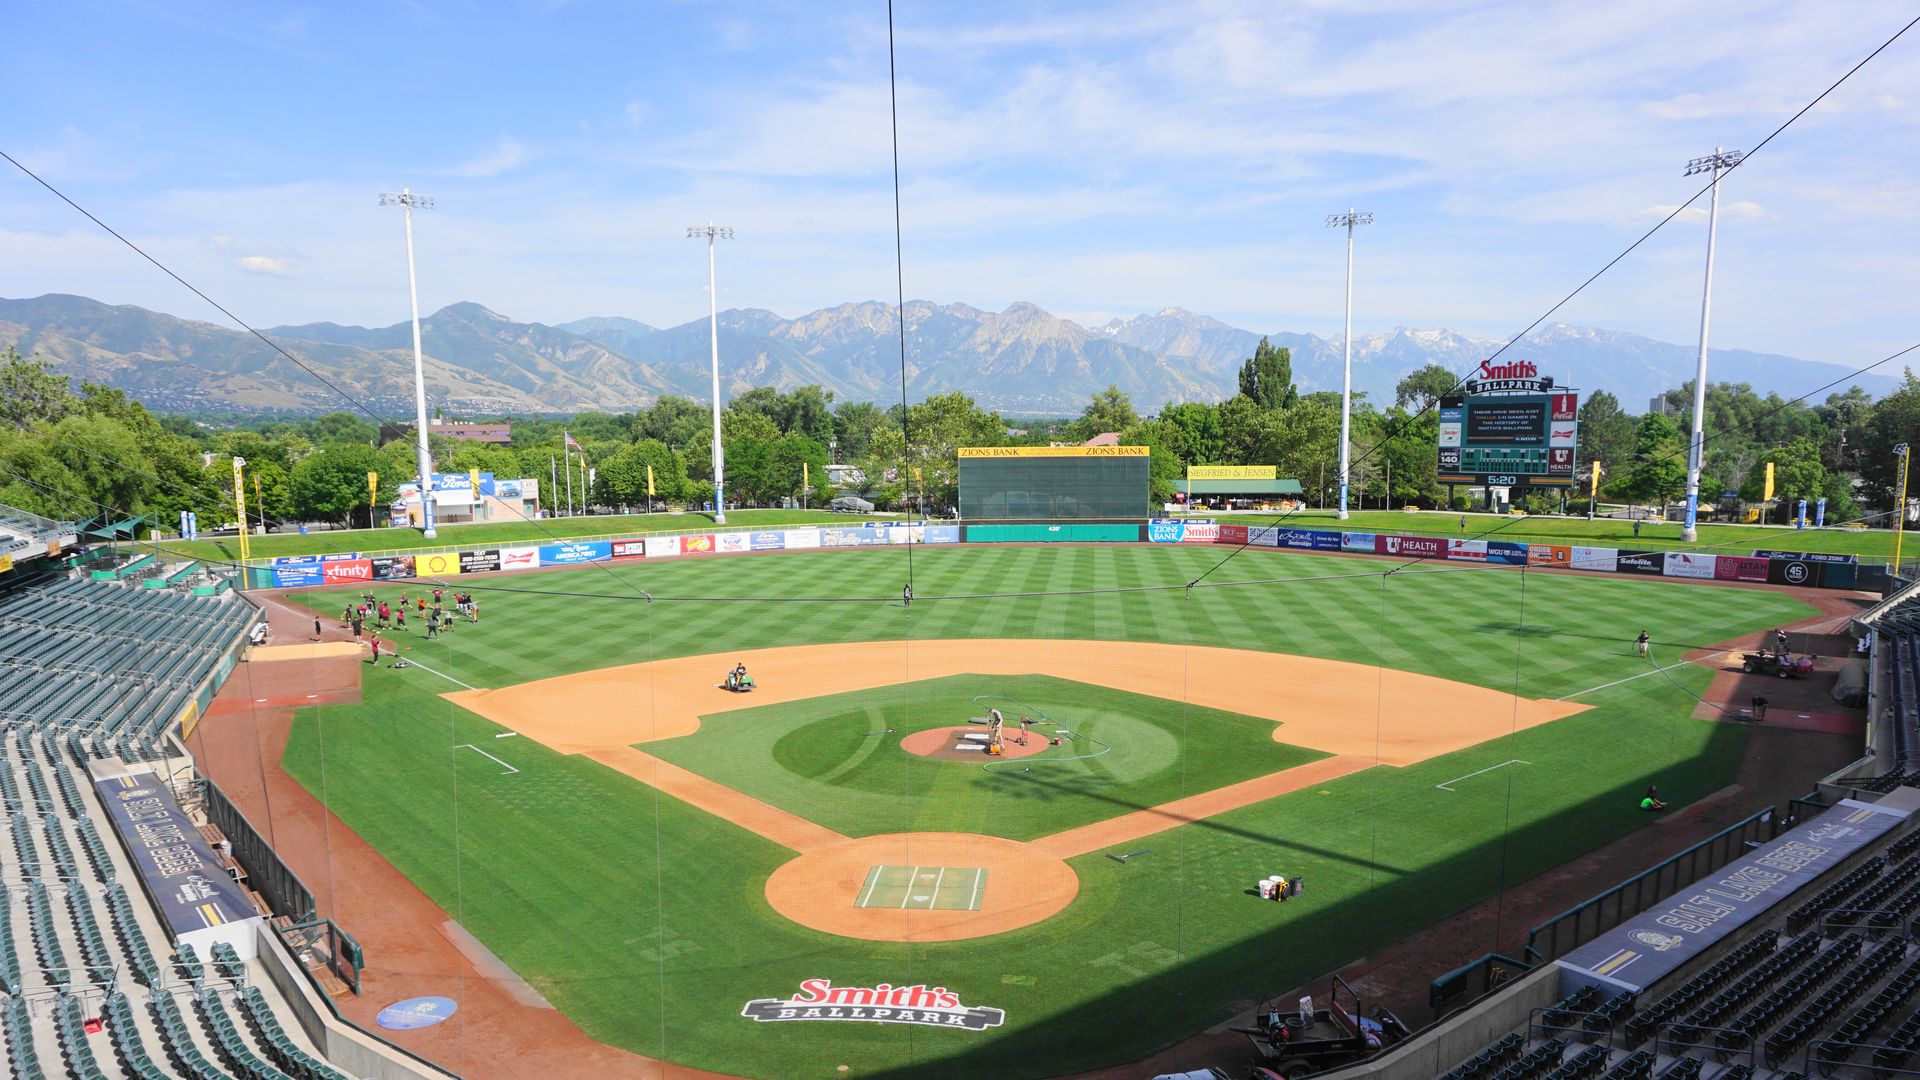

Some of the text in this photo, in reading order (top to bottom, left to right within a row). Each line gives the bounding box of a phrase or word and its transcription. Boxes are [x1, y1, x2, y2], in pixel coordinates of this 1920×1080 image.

[1480, 360, 1537, 380] Smith's
[1477, 380, 1541, 392] BALLPARK
[1190, 467, 1275, 478] SIEGFRIED & JENSEN
[441, 475, 471, 488] Ford
[1488, 476, 1516, 485] 5:20
[1154, 532, 1178, 540] BANK
[1185, 525, 1219, 538] Smith's
[1403, 541, 1437, 551] HEALTH
[1620, 558, 1652, 566] Safelite
[1688, 563, 1710, 571] Security
[326, 564, 369, 580] xfinity
[132, 817, 185, 848] LAKE
[150, 843, 204, 877] BEES
[1656, 841, 1829, 934] SALT LAKE BEES
[794, 979, 959, 1009] Smith's
[777, 1007, 967, 1026] BALLPARK
